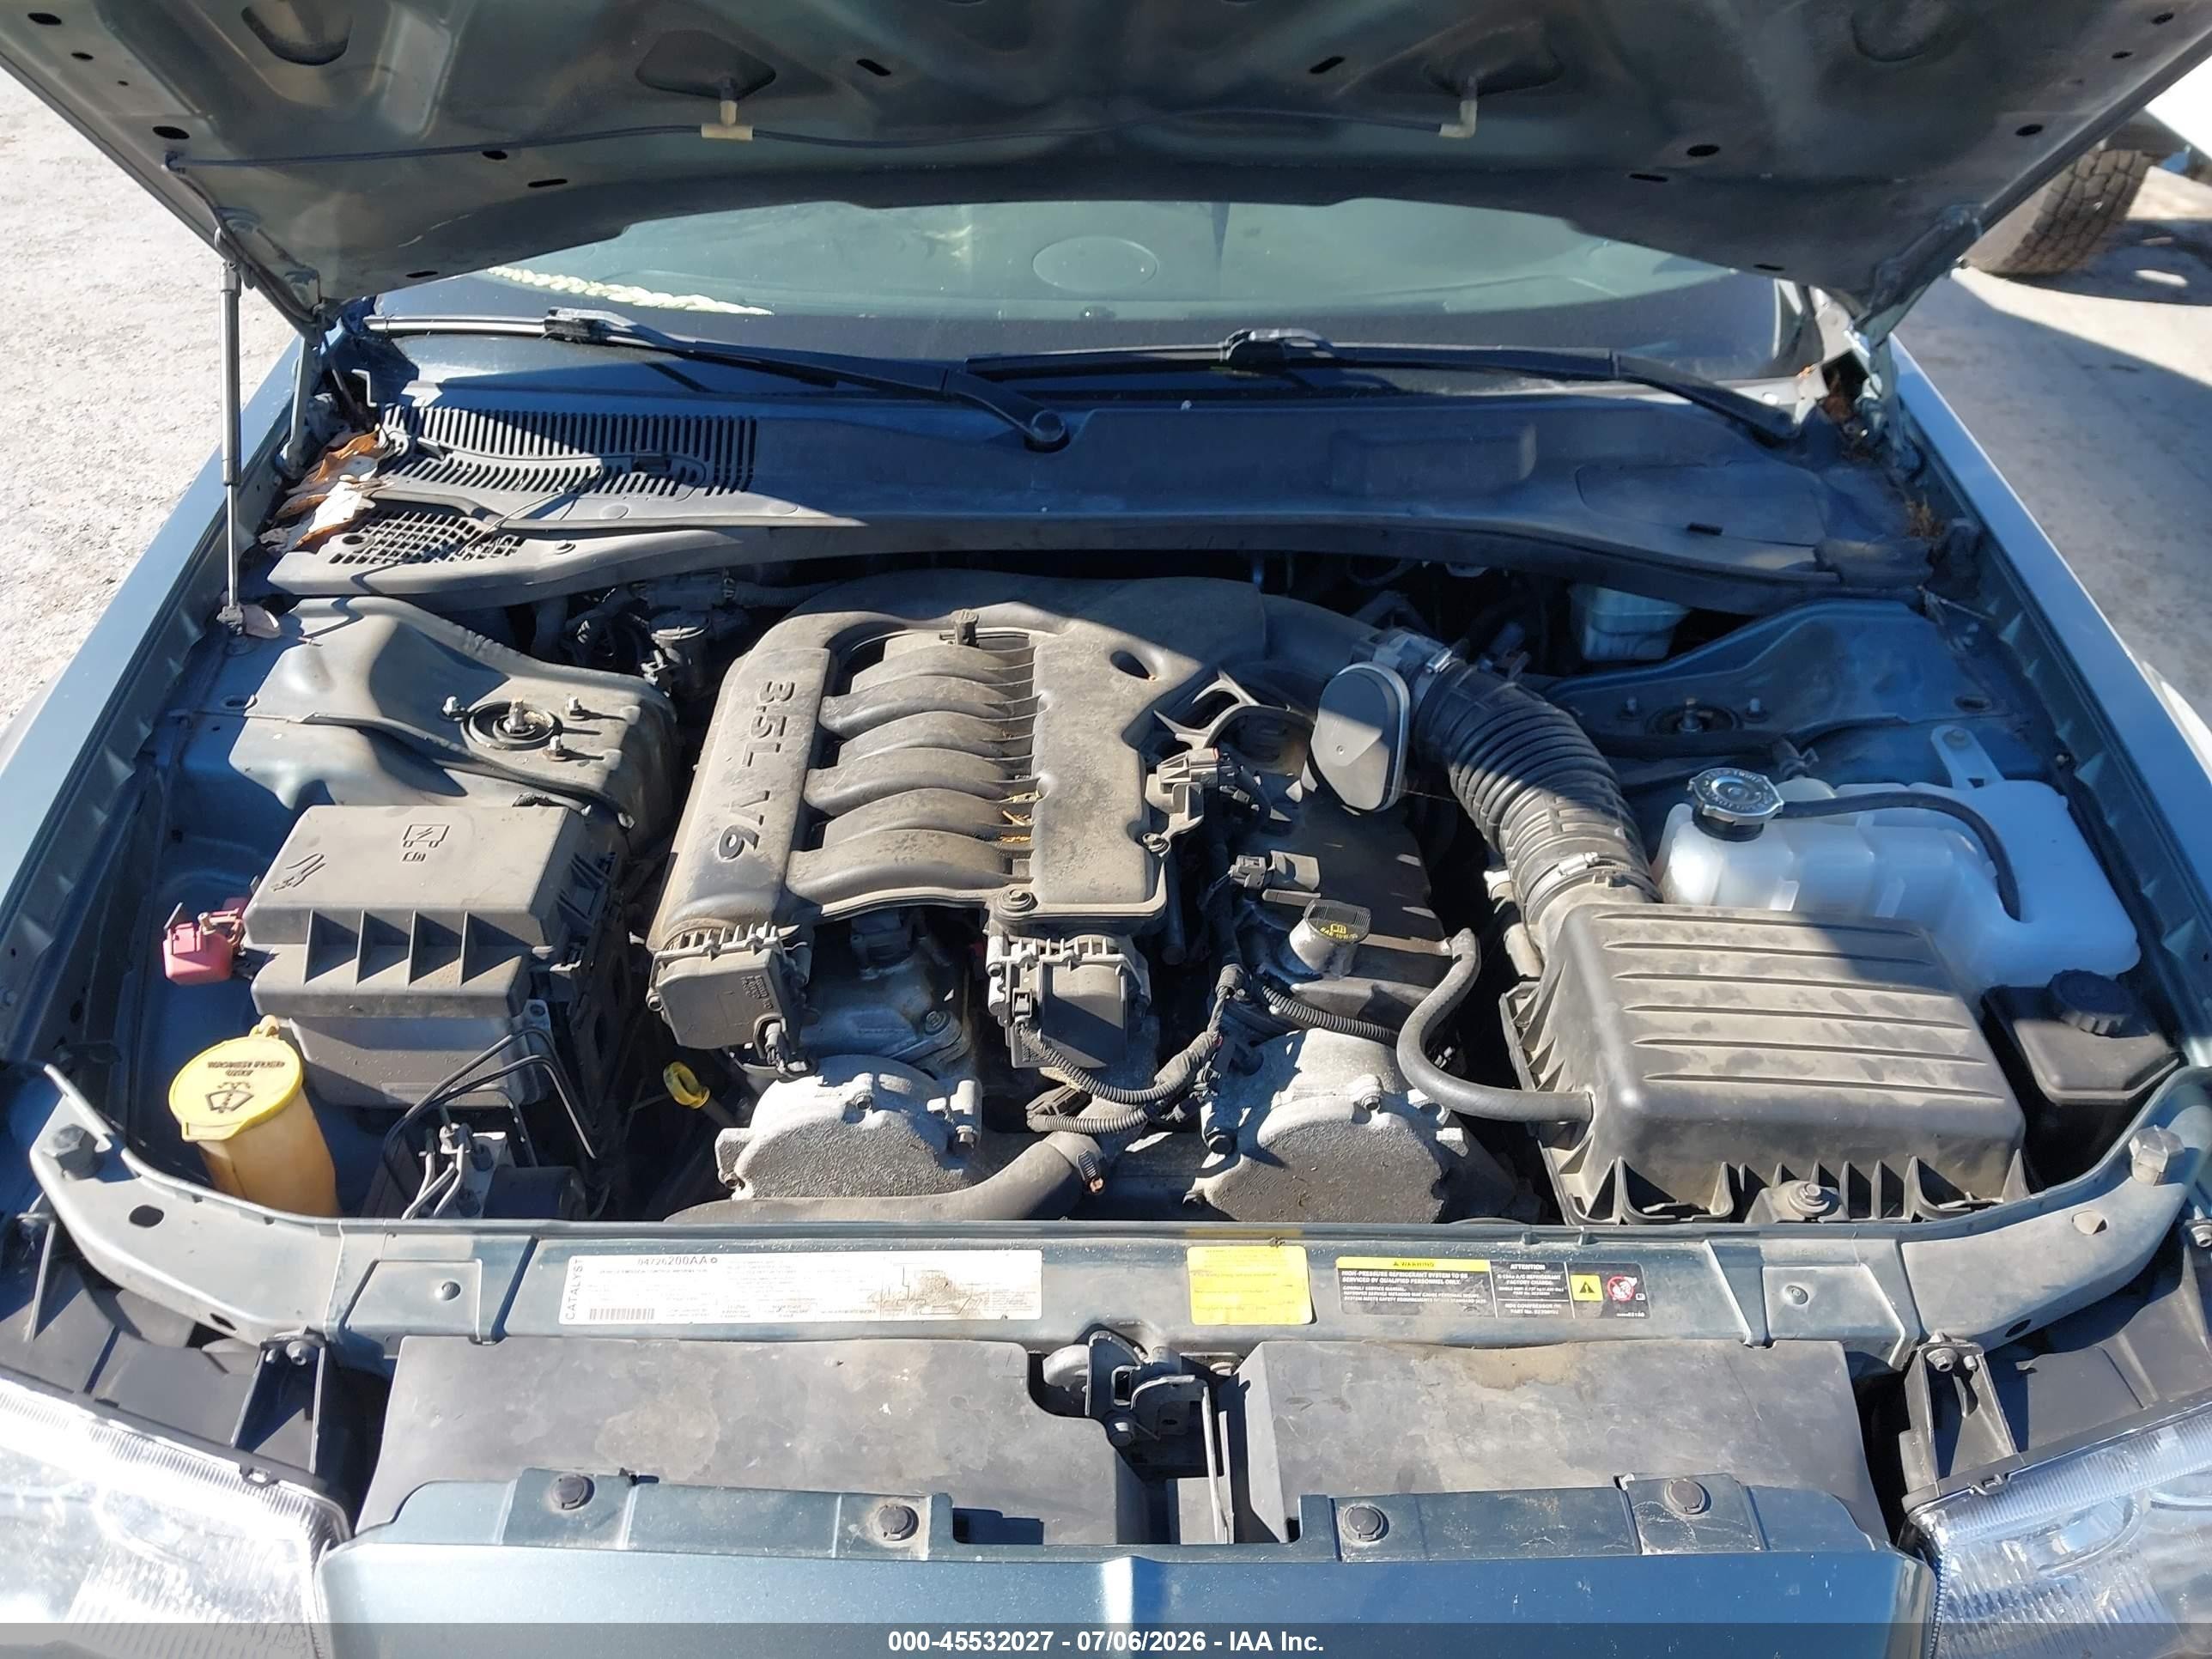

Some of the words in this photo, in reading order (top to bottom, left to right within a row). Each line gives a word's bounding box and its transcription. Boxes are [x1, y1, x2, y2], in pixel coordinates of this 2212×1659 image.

[741, 680, 796, 769] 3.5L
[718, 789, 772, 862] V6
[565, 1259, 584, 1320] CATALYST
